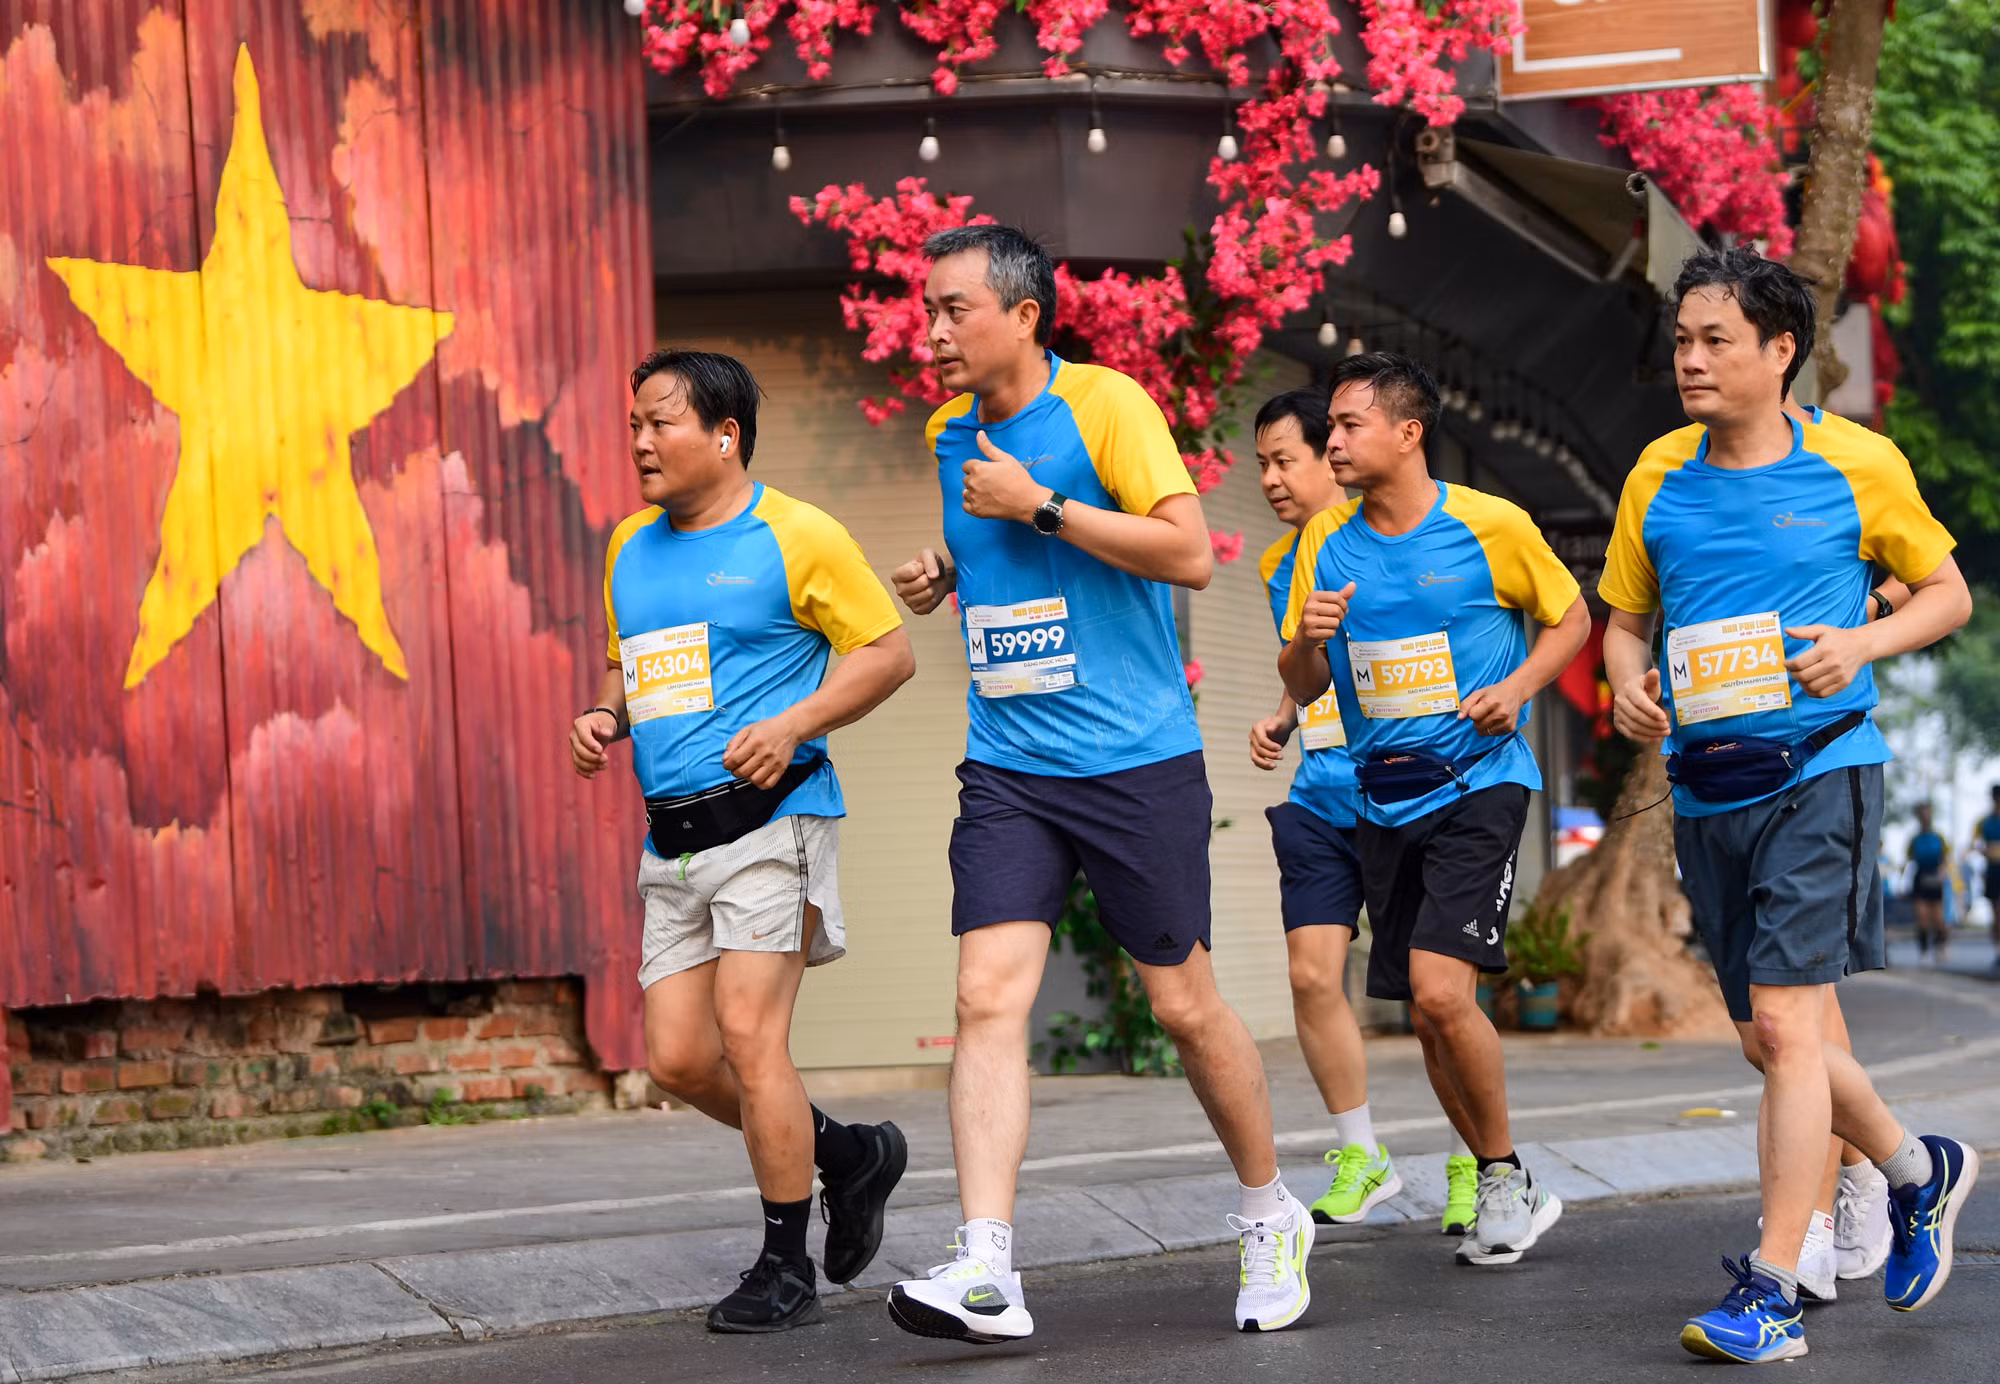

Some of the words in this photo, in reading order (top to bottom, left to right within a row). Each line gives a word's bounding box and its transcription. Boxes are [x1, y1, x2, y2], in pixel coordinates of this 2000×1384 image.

[972, 638, 983, 654] M
[990, 625, 1065, 657] 59999
[626, 667, 636, 685] M
[642, 650, 705, 683] 56304
[1356, 669, 1370, 682] M
[1380, 658, 1449, 685] 59793
[1673, 661, 1687, 680] M
[1698, 642, 1779, 678] 57734
[1314, 694, 1339, 716] 57
